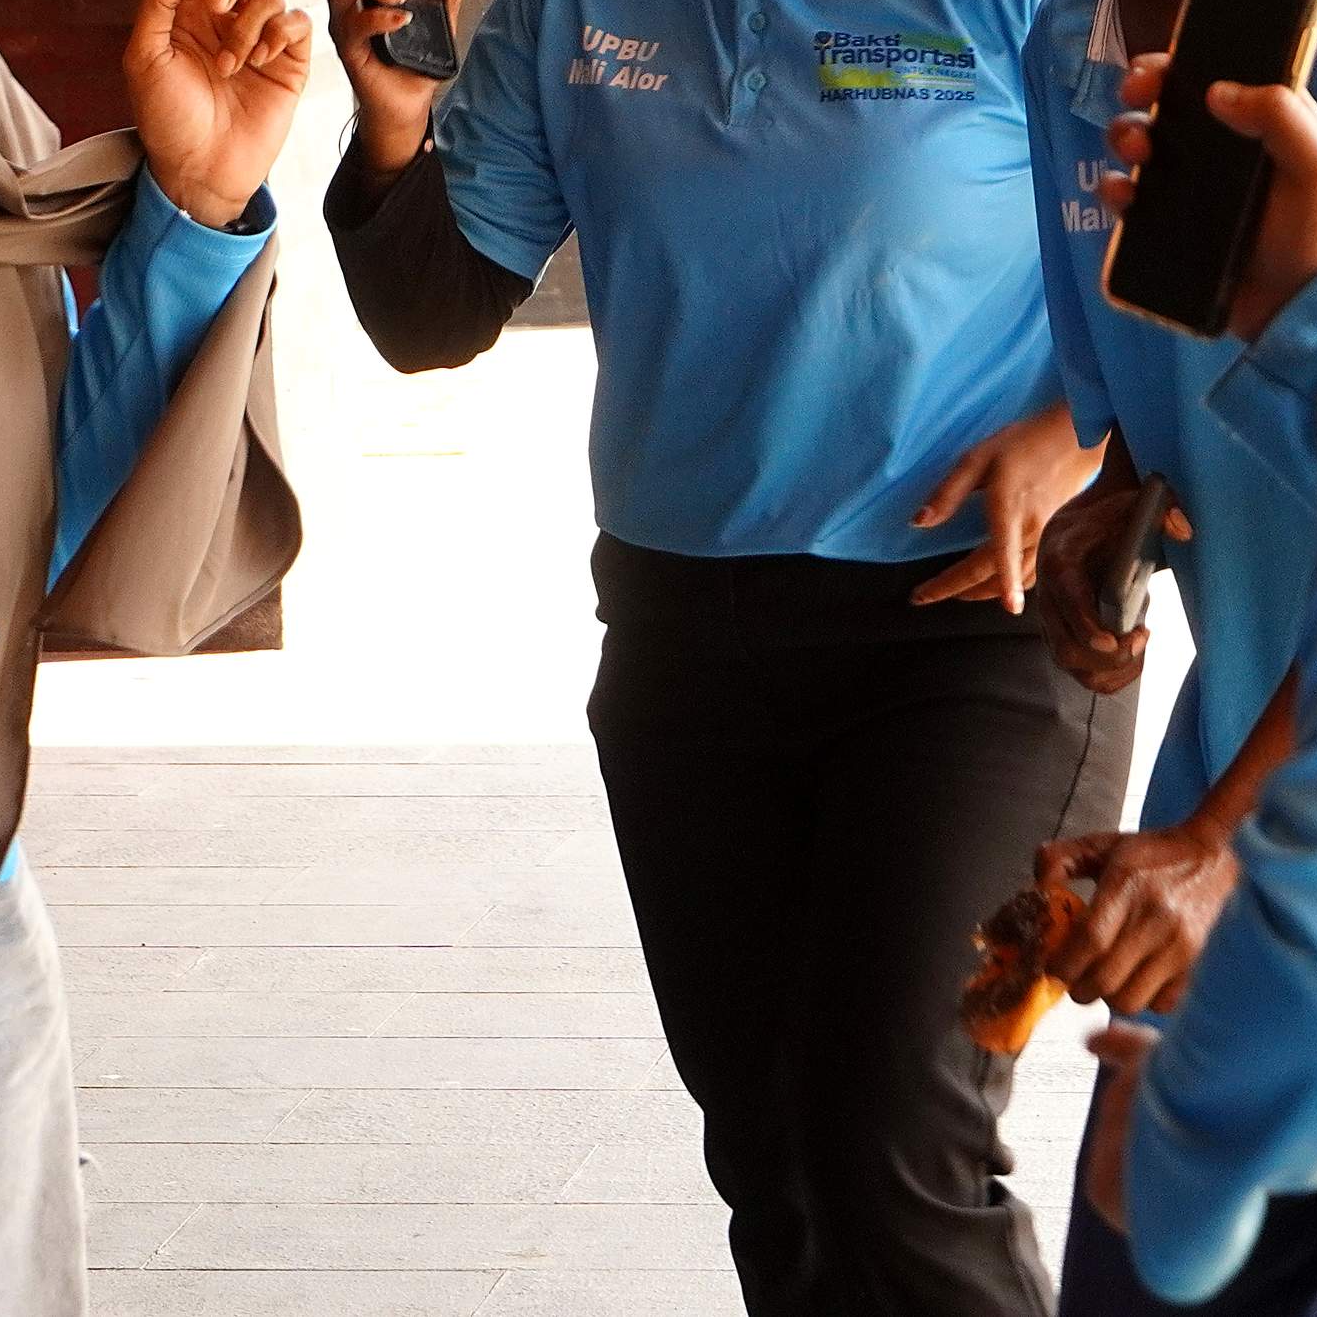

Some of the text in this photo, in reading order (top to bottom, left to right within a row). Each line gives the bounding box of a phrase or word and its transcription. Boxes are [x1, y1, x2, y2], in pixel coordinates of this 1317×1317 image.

[582, 25, 660, 62] UPBU
[833, 32, 902, 48] Bakti
[813, 46, 977, 69] Transportasi
[608, 66, 669, 92] Alor
[819, 87, 975, 103] HARHUBNAS 2025
